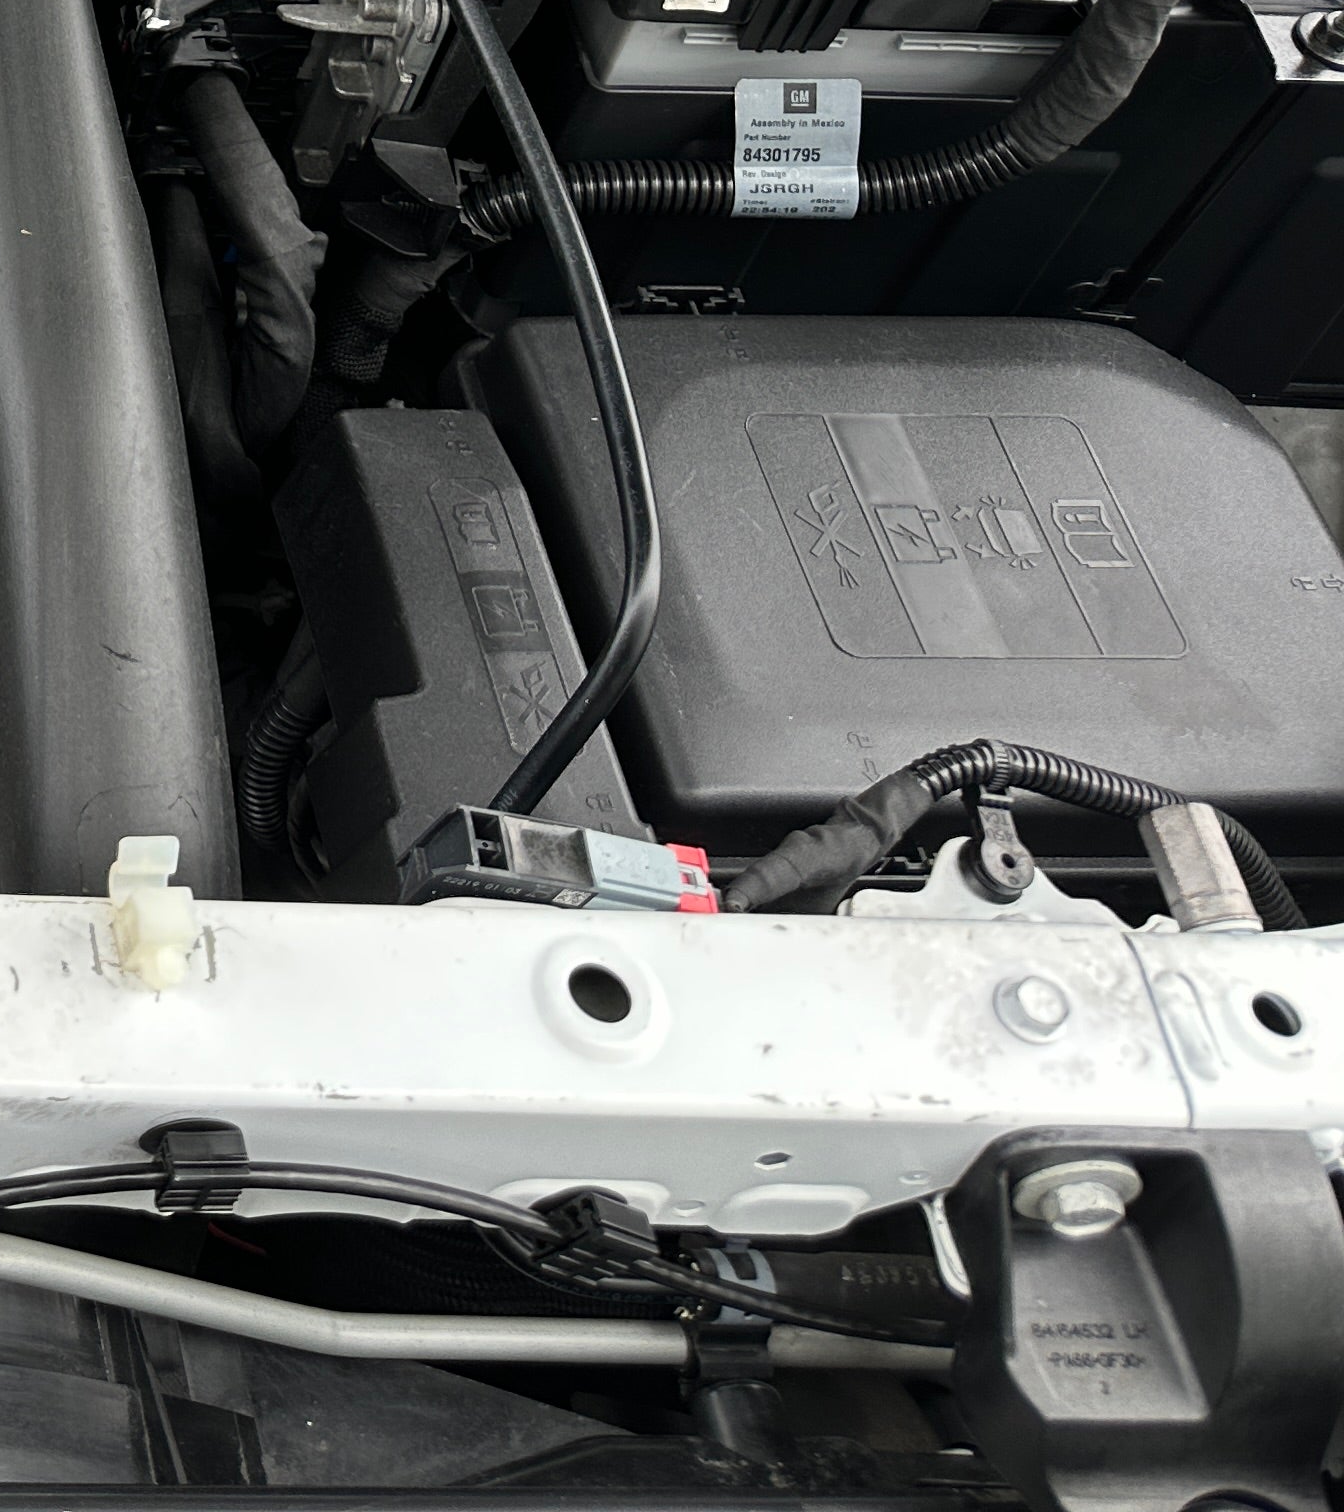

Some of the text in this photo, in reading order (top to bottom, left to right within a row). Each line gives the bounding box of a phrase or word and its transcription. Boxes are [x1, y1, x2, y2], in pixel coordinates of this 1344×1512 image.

[791, 89, 810, 103] GM
[751, 118, 845, 129] Assembly in Mexico
[743, 148, 821, 162] 84301795
[749, 183, 814, 194] JSRGH
